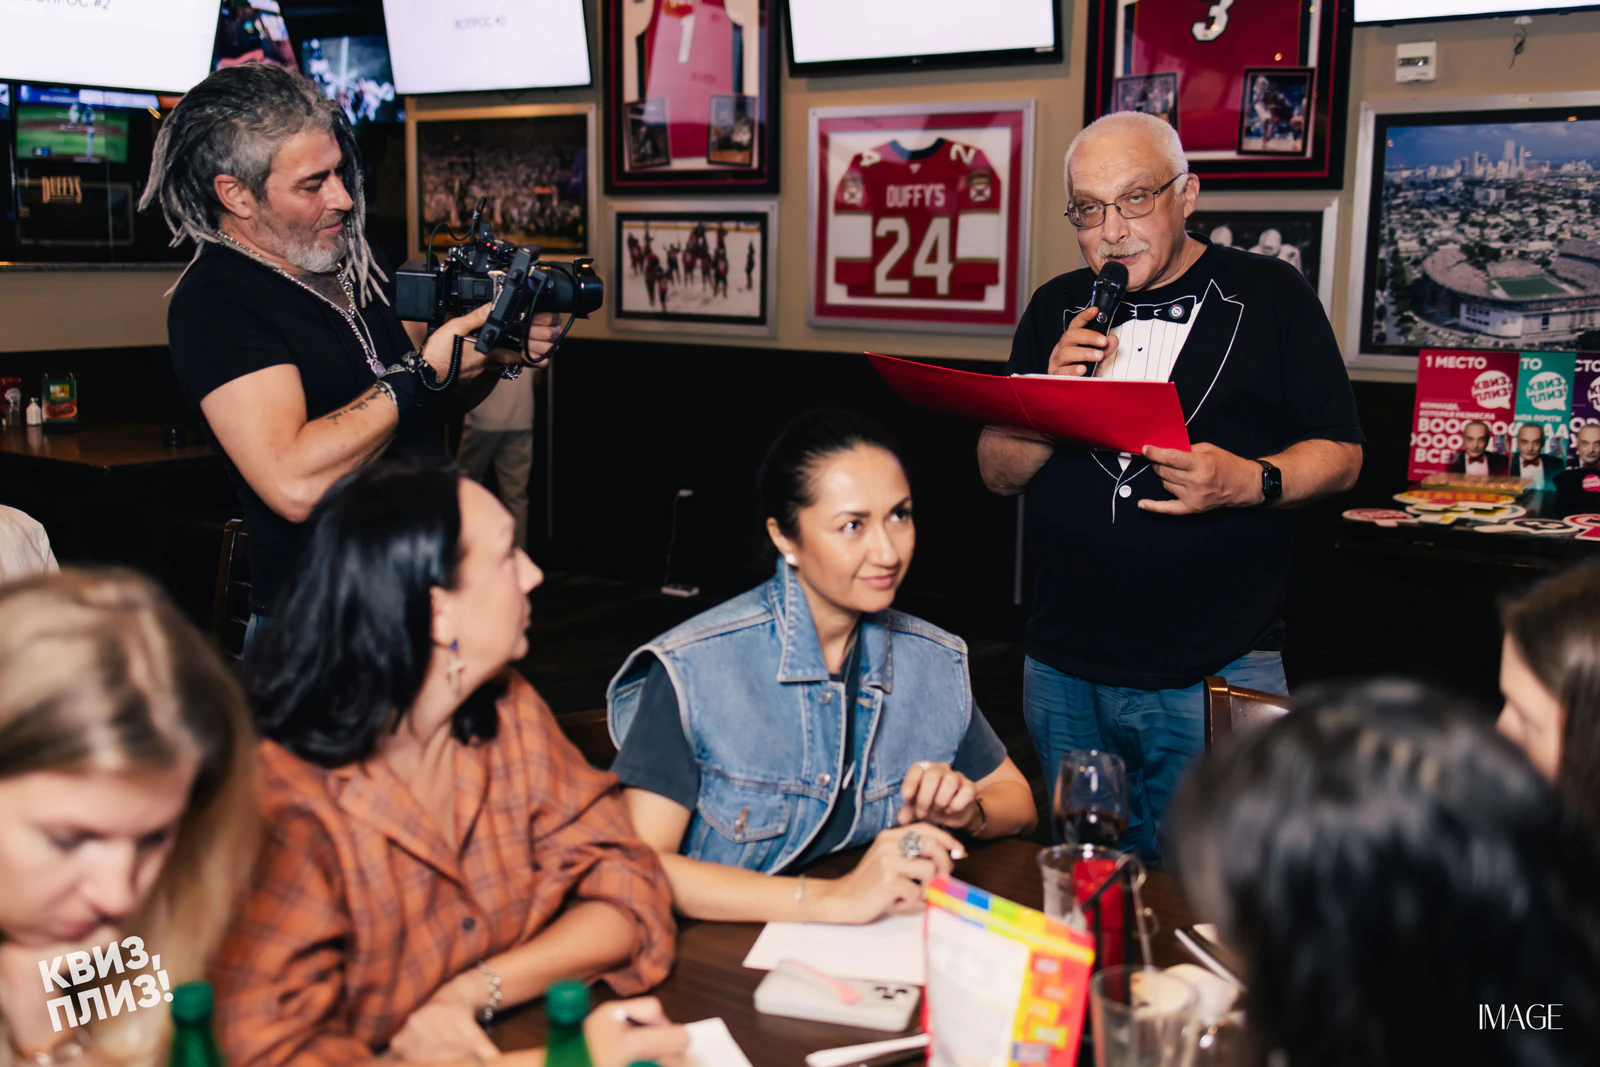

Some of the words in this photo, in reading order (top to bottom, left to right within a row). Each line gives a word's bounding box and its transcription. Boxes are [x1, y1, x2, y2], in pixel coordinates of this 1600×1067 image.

[886, 183, 946, 208] DUFFYS
[874, 215, 955, 296] 24
[1425, 355, 1433, 368] 1
[1435, 355, 1488, 370] МЕСТО
